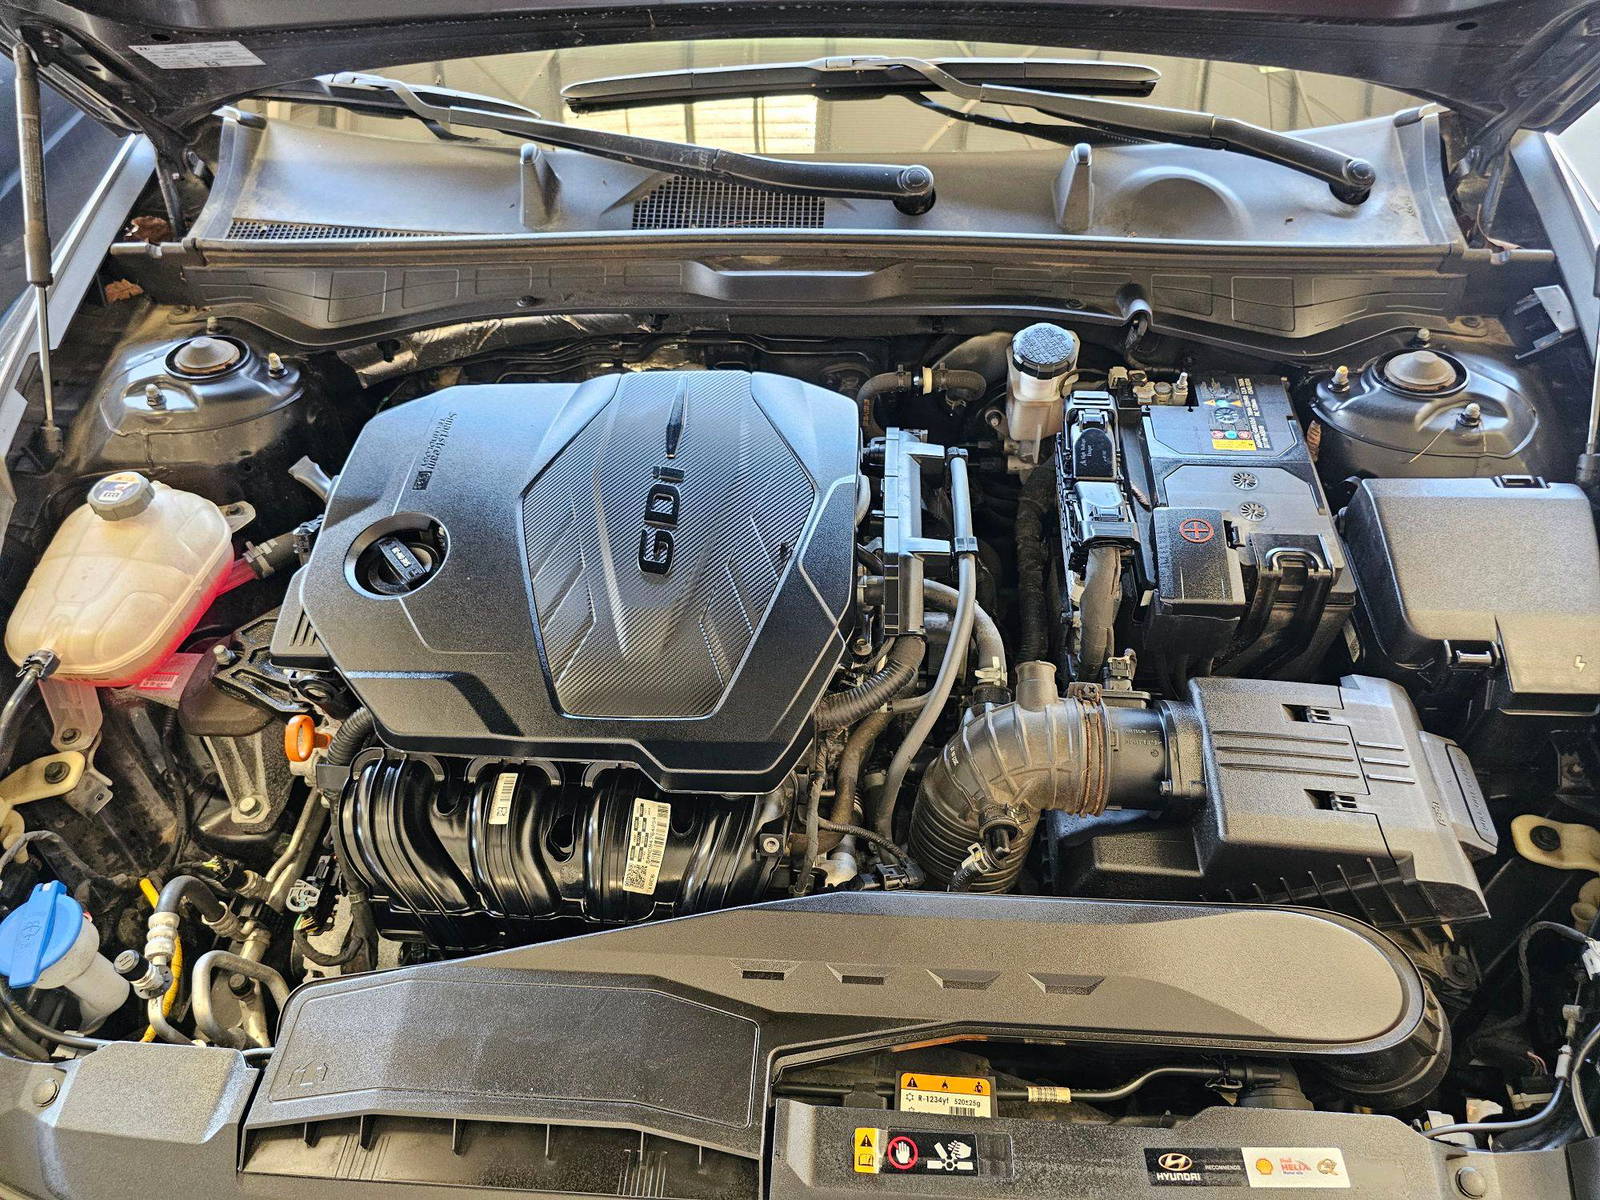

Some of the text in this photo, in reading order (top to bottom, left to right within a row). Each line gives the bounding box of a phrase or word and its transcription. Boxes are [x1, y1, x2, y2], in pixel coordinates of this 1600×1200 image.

[427, 411, 457, 469] Smartstream
[638, 465, 685, 577] GDi
[917, 1094, 981, 1108] R-1234yf 520±25g
[1280, 1161, 1312, 1171] HELIX
[1156, 1172, 1201, 1182] HYUNDAI
